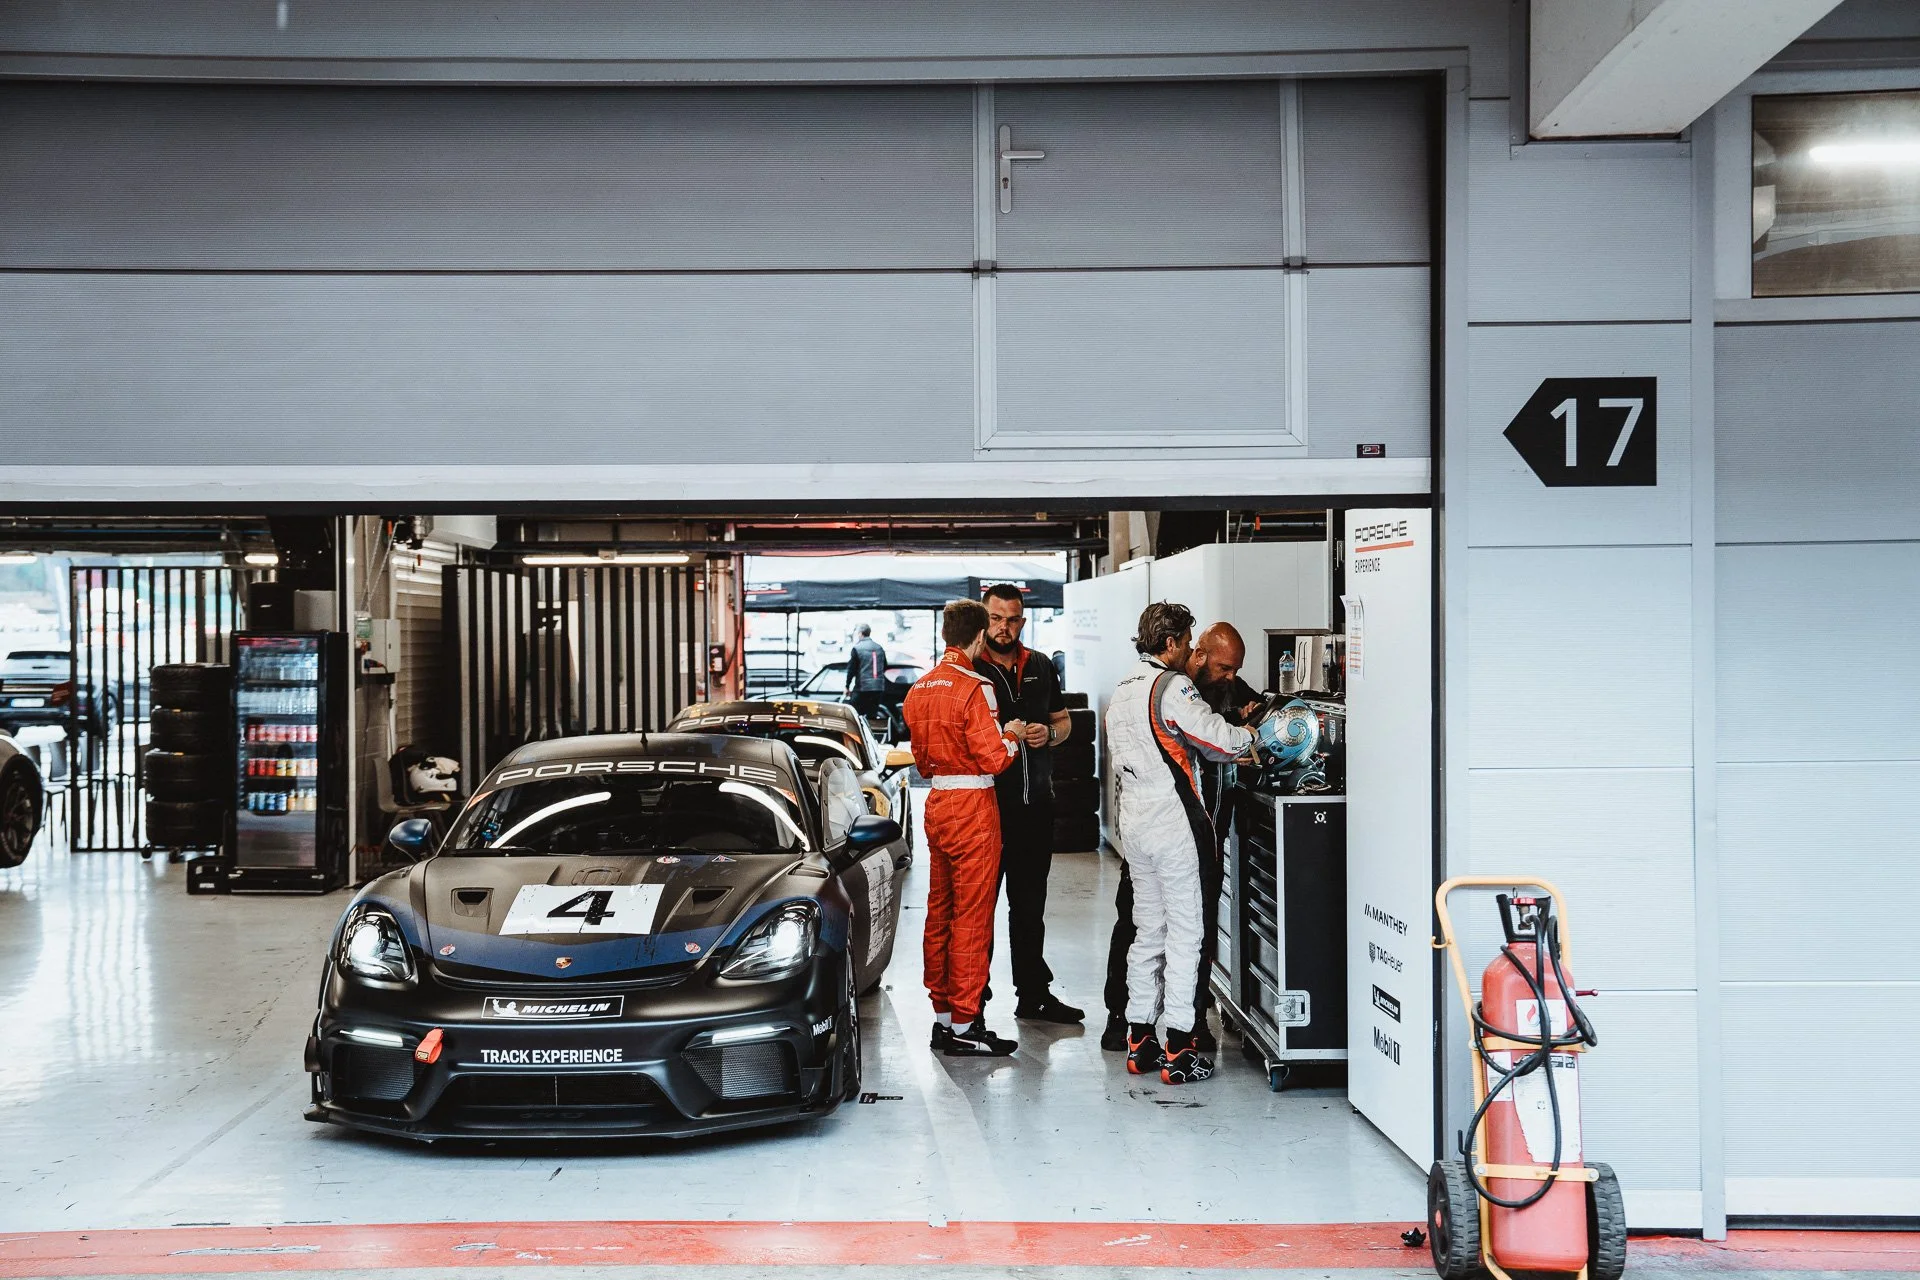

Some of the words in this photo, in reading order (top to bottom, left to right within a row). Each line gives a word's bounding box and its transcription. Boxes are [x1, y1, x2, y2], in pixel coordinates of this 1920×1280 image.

[1550, 397, 1644, 467] 17
[1354, 520, 1408, 543] PORSCHE
[1354, 557, 1381, 574] EXPERIENCE
[676, 714, 848, 730] PORSCHE
[496, 760, 777, 785] PORSCHE
[547, 889, 615, 925] 4
[1372, 906, 1408, 937] MANTHEY
[521, 1002, 611, 1014] MICHELIN
[1379, 995, 1399, 1015] MICHELIN
[480, 1049, 530, 1064] TRACK
[532, 1048, 623, 1064] EXPERIENCE
[1373, 1025, 1393, 1060] Mobil
[1393, 1040, 1401, 1066] 1
